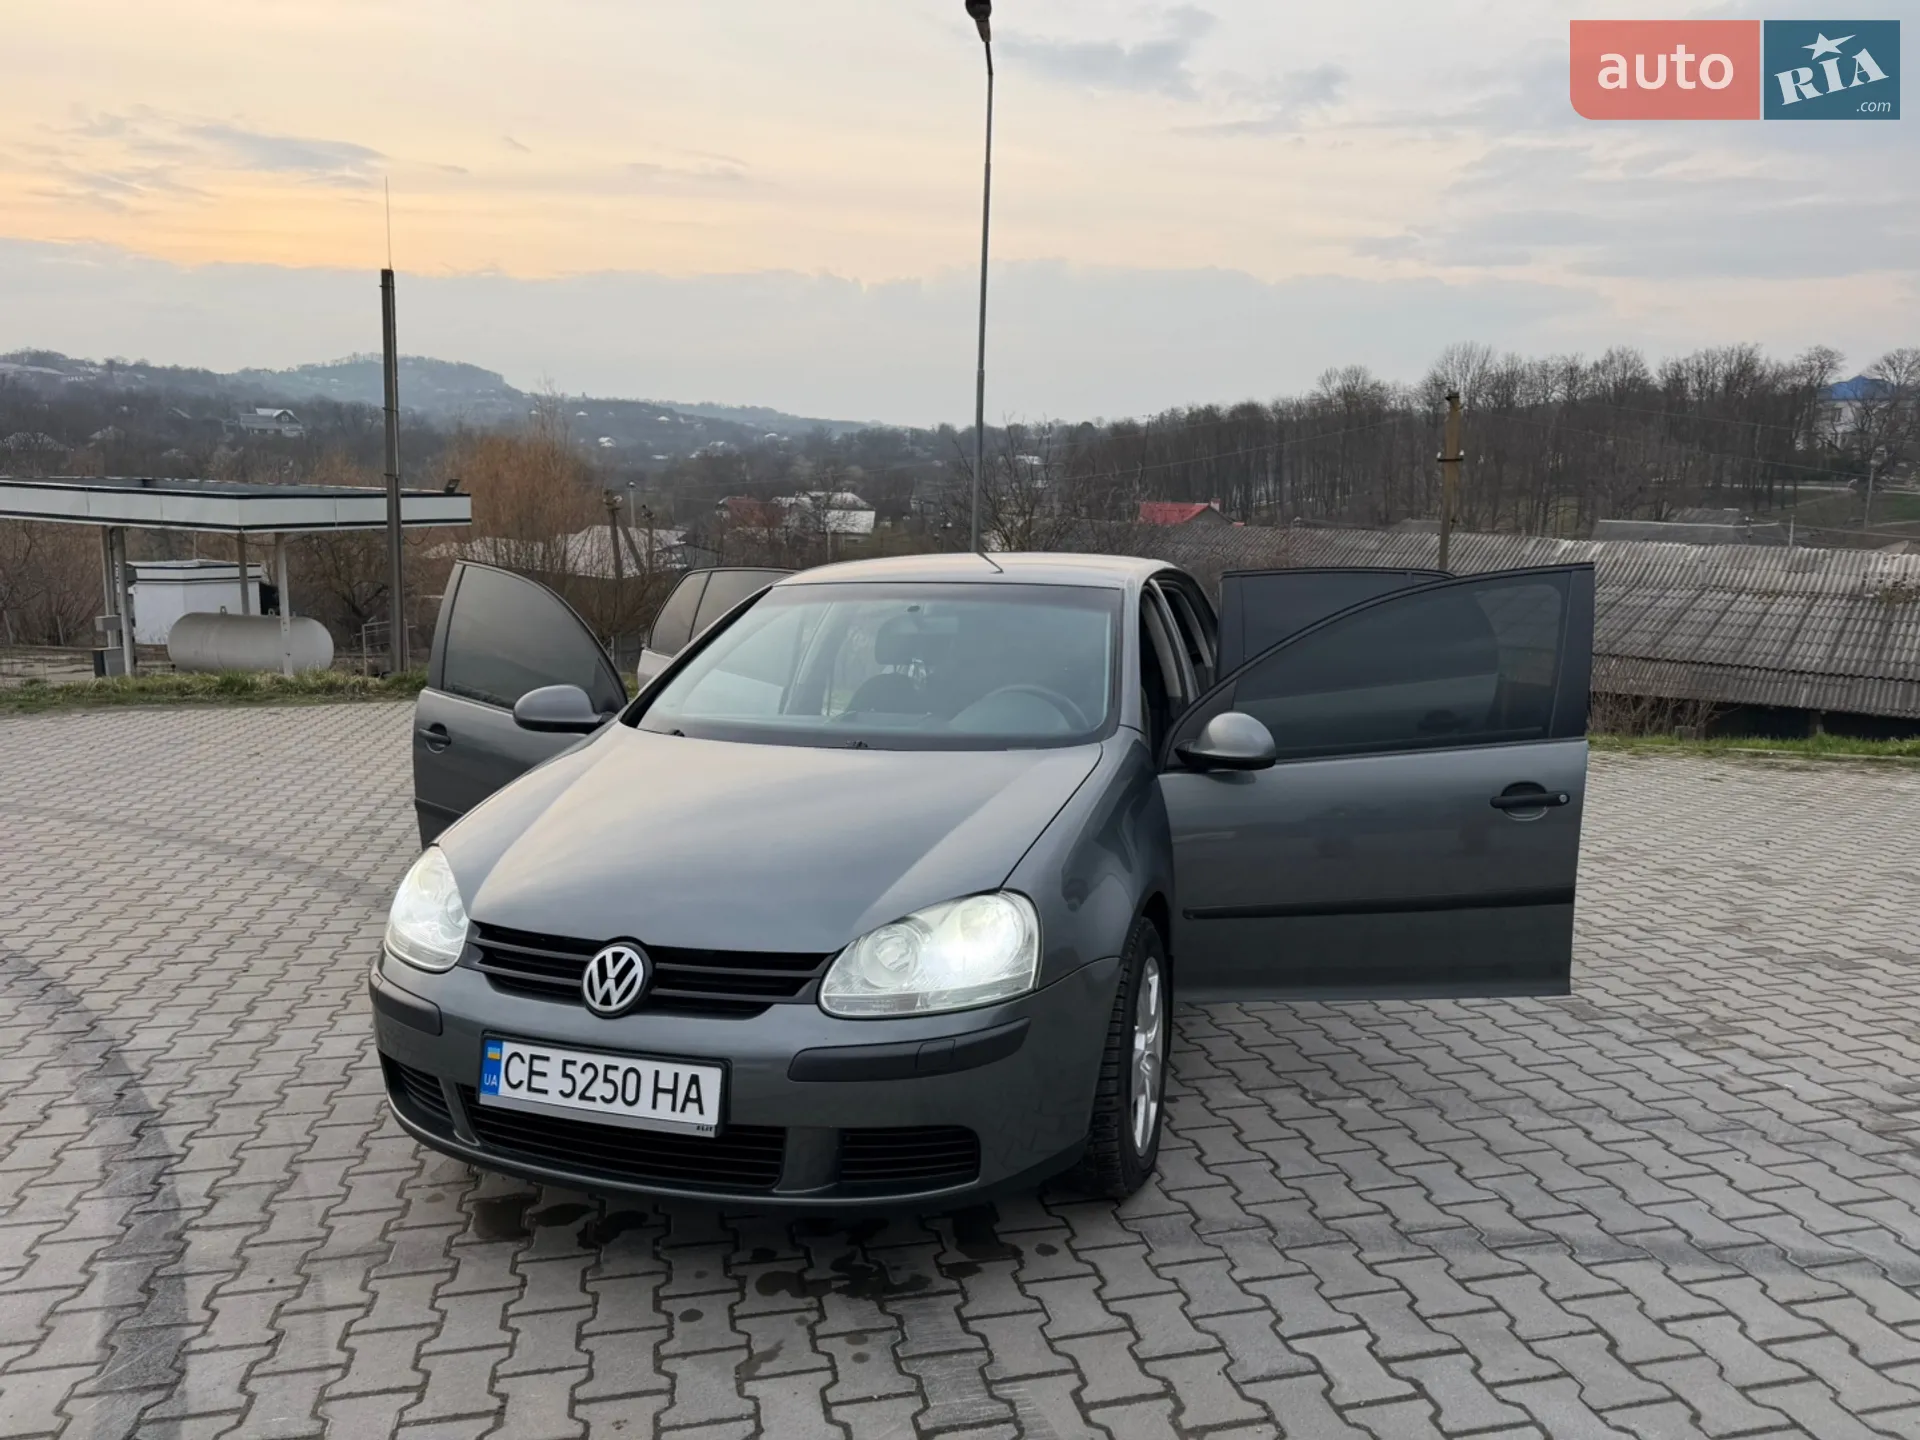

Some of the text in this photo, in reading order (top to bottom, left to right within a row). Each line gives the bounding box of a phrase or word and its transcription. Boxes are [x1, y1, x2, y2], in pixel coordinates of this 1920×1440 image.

[484, 1074, 497, 1087] UA
[504, 1050, 704, 1115] CE 5250 HA
